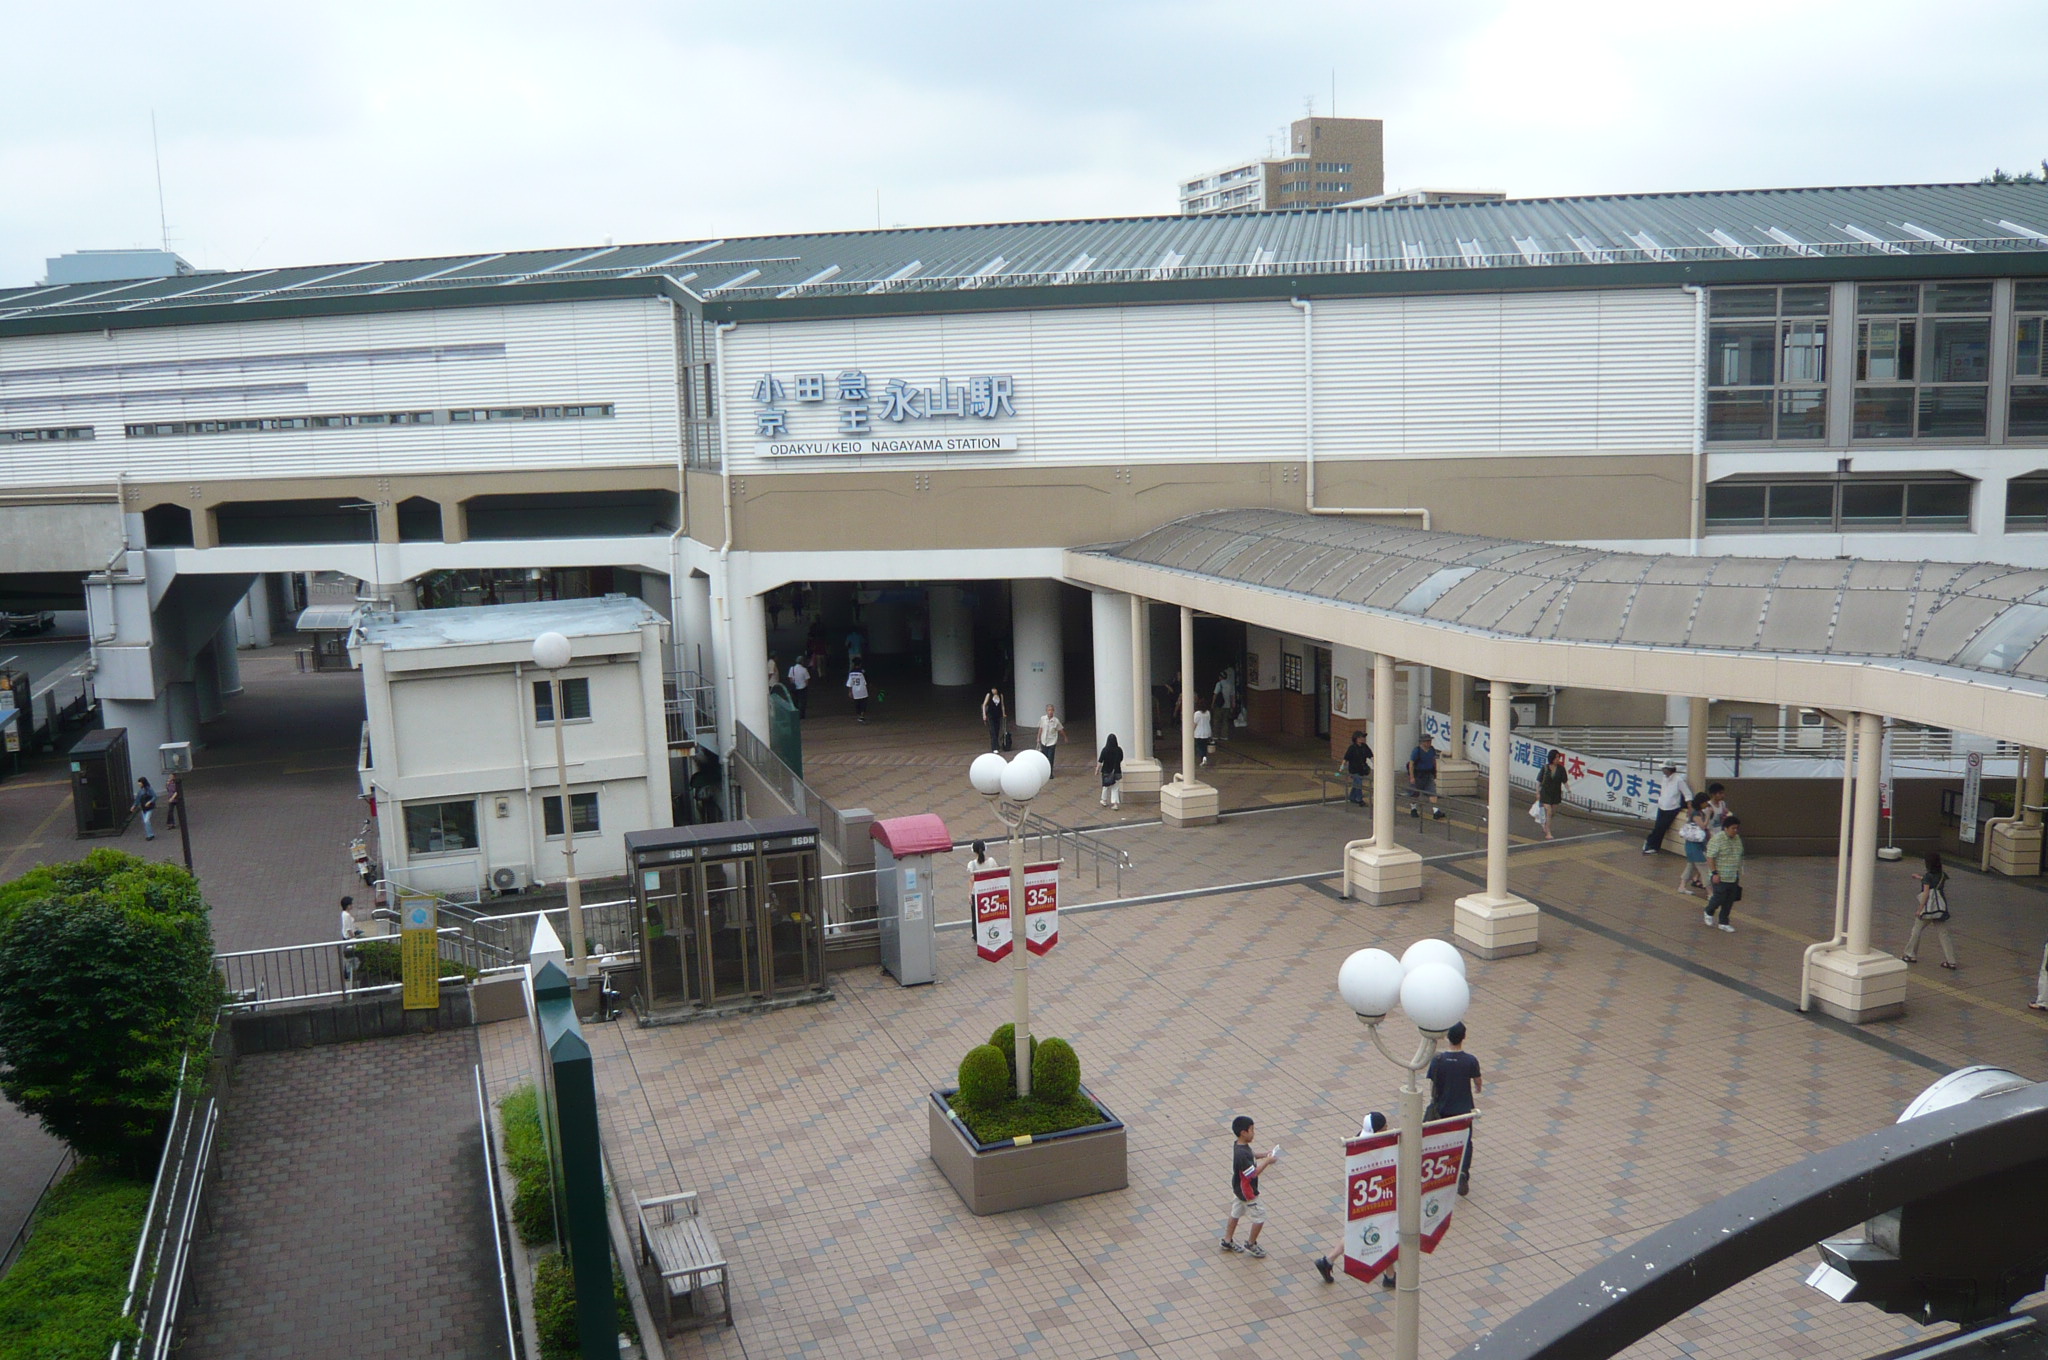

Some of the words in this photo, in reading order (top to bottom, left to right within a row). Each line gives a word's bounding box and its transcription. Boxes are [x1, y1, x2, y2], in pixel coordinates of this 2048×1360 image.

[752, 369, 870, 403] 小田急
[878, 375, 1016, 422] 永山駅
[753, 404, 872, 437] 京王
[871, 439, 943, 452] NAGAYAMA
[947, 437, 1001, 450] STATION
[731, 842, 755, 853] ISDN
[792, 836, 815, 847] ISDN
[669, 849, 693, 860] ISDN
[980, 894, 1008, 914] 35th
[1028, 888, 1055, 907] 35th
[1421, 1155, 1457, 1183] 35th
[1353, 1175, 1393, 1207] 35th
[1352, 1199, 1394, 1215] ANNIVERSARY
